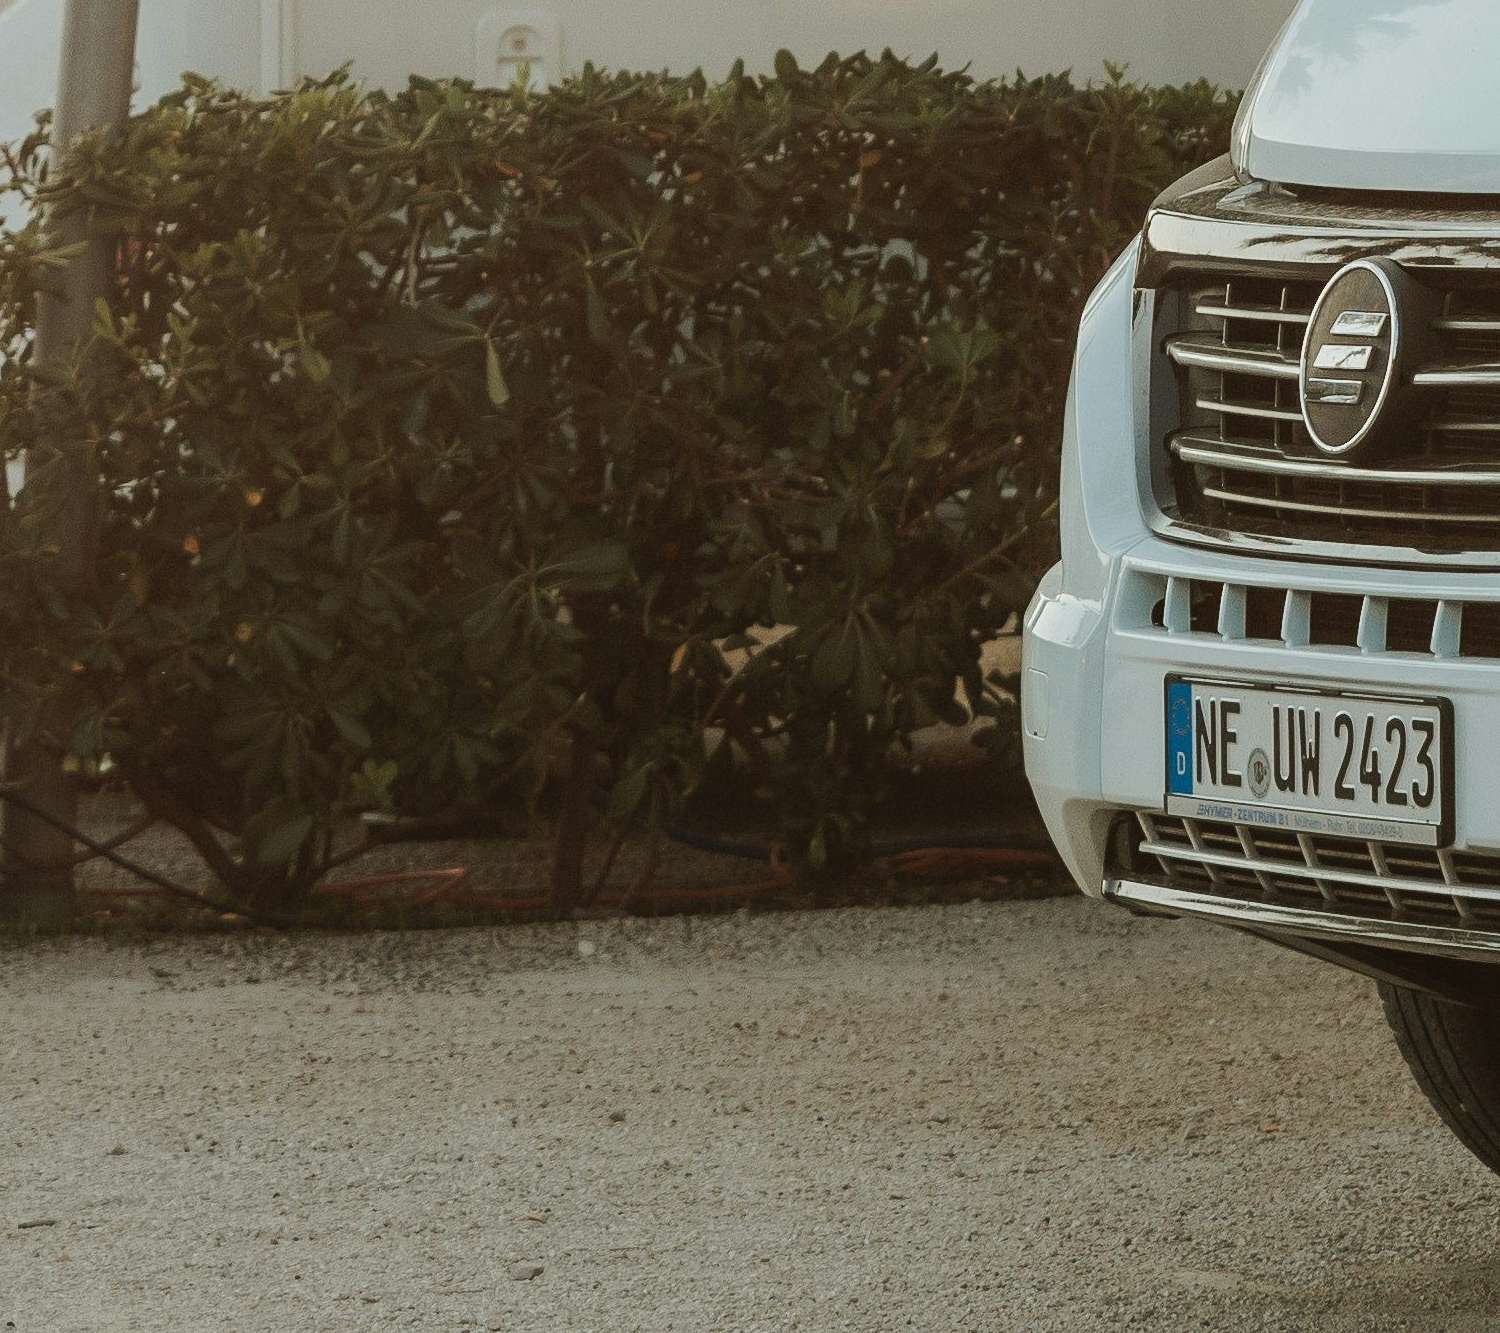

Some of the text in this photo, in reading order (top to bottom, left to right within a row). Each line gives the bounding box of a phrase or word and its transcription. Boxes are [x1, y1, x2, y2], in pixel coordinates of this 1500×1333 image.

[1177, 751, 1187, 775] D
[1195, 696, 1434, 807] NE UW 2423
